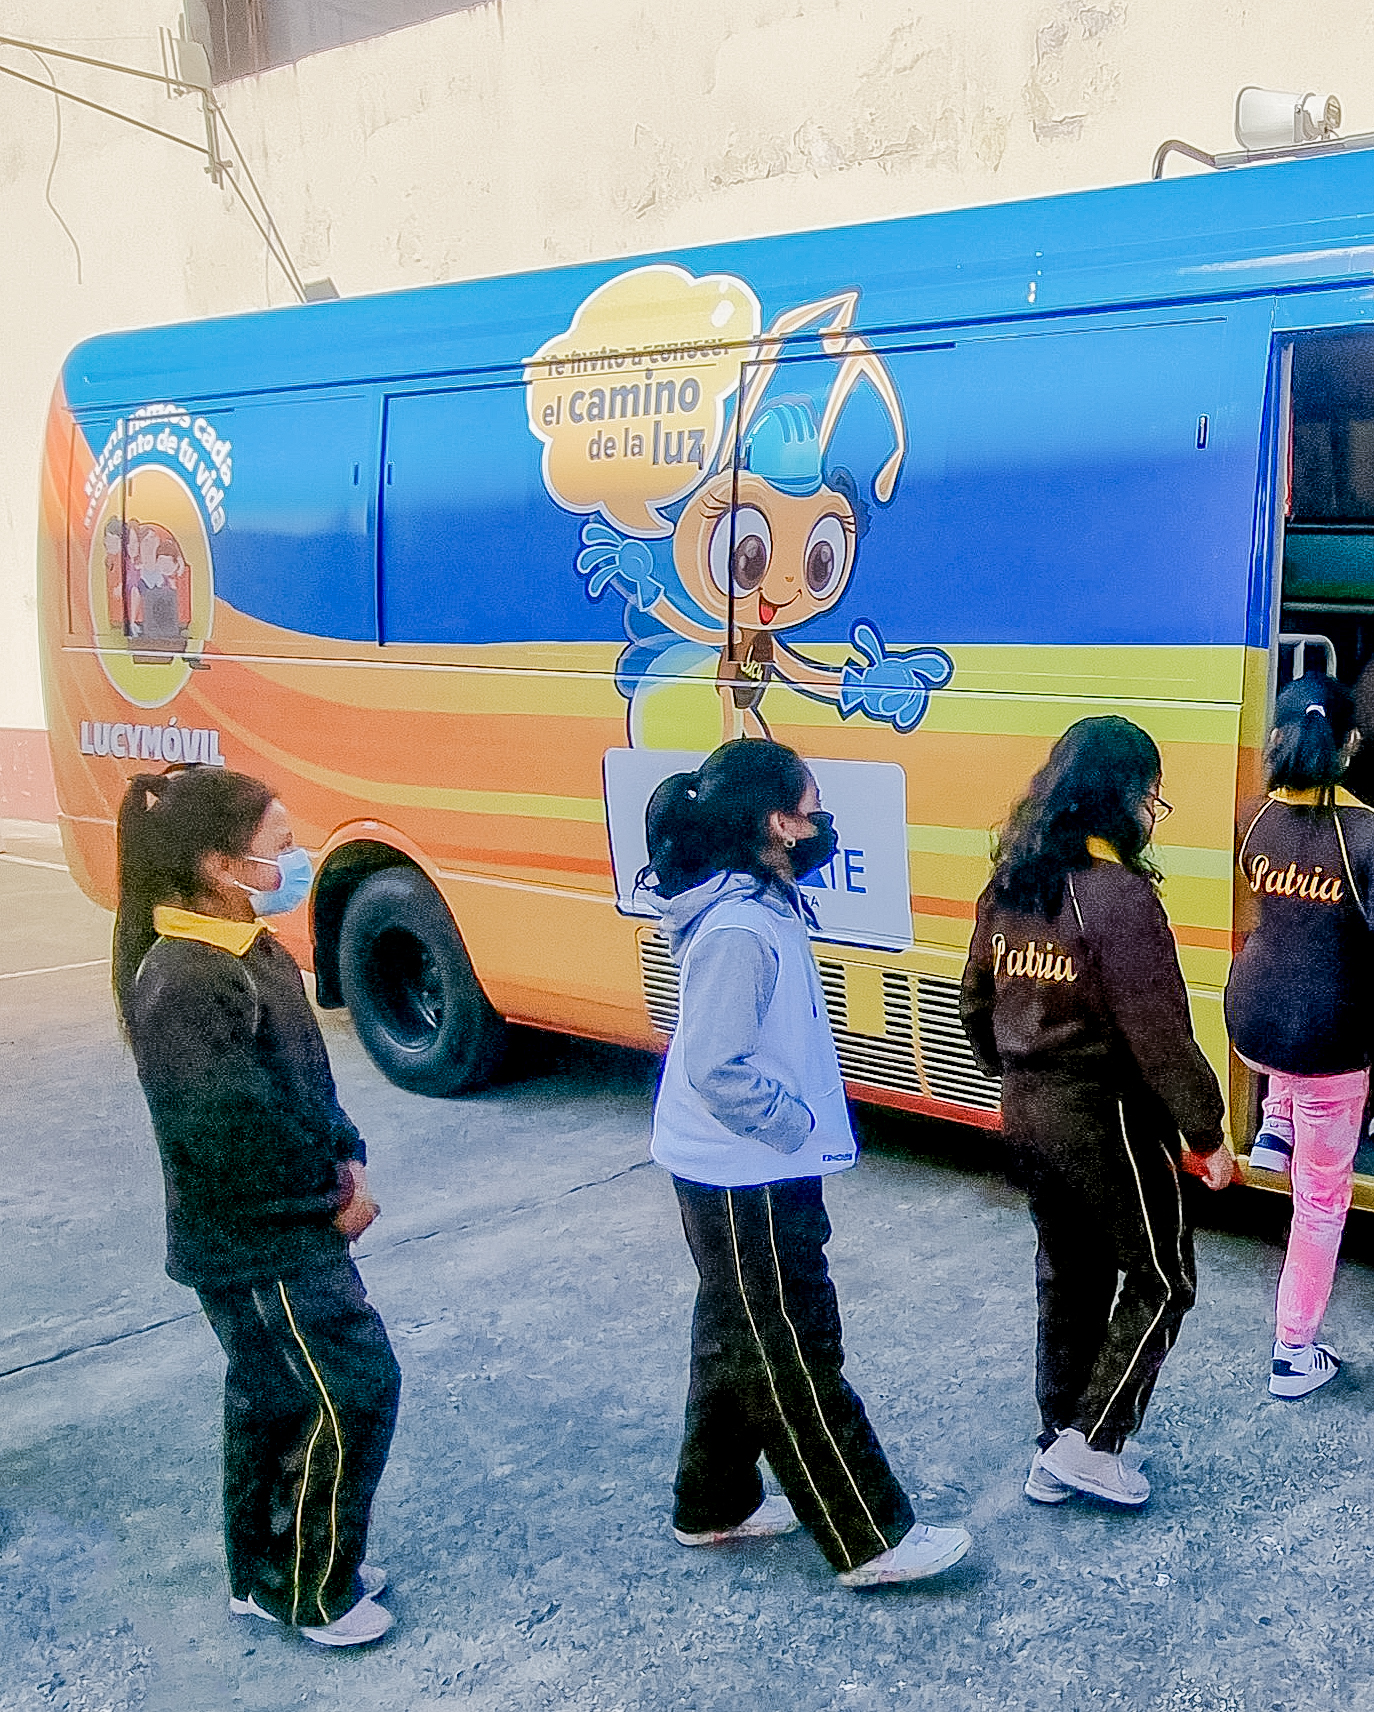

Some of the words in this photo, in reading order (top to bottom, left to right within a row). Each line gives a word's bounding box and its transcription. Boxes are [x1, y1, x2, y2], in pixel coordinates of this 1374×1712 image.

[542, 396, 562, 425] el
[569, 367, 700, 423] camino
[193, 417, 232, 487] cada
[588, 430, 617, 460] de
[624, 428, 644, 457] la
[653, 420, 705, 470] luz
[156, 427, 178, 454] de
[179, 437, 198, 472] tu
[197, 461, 226, 534] vida
[81, 716, 226, 767] LUCYMÓVIL
[1250, 854, 1344, 903] Patria
[992, 932, 1078, 982] Patria
